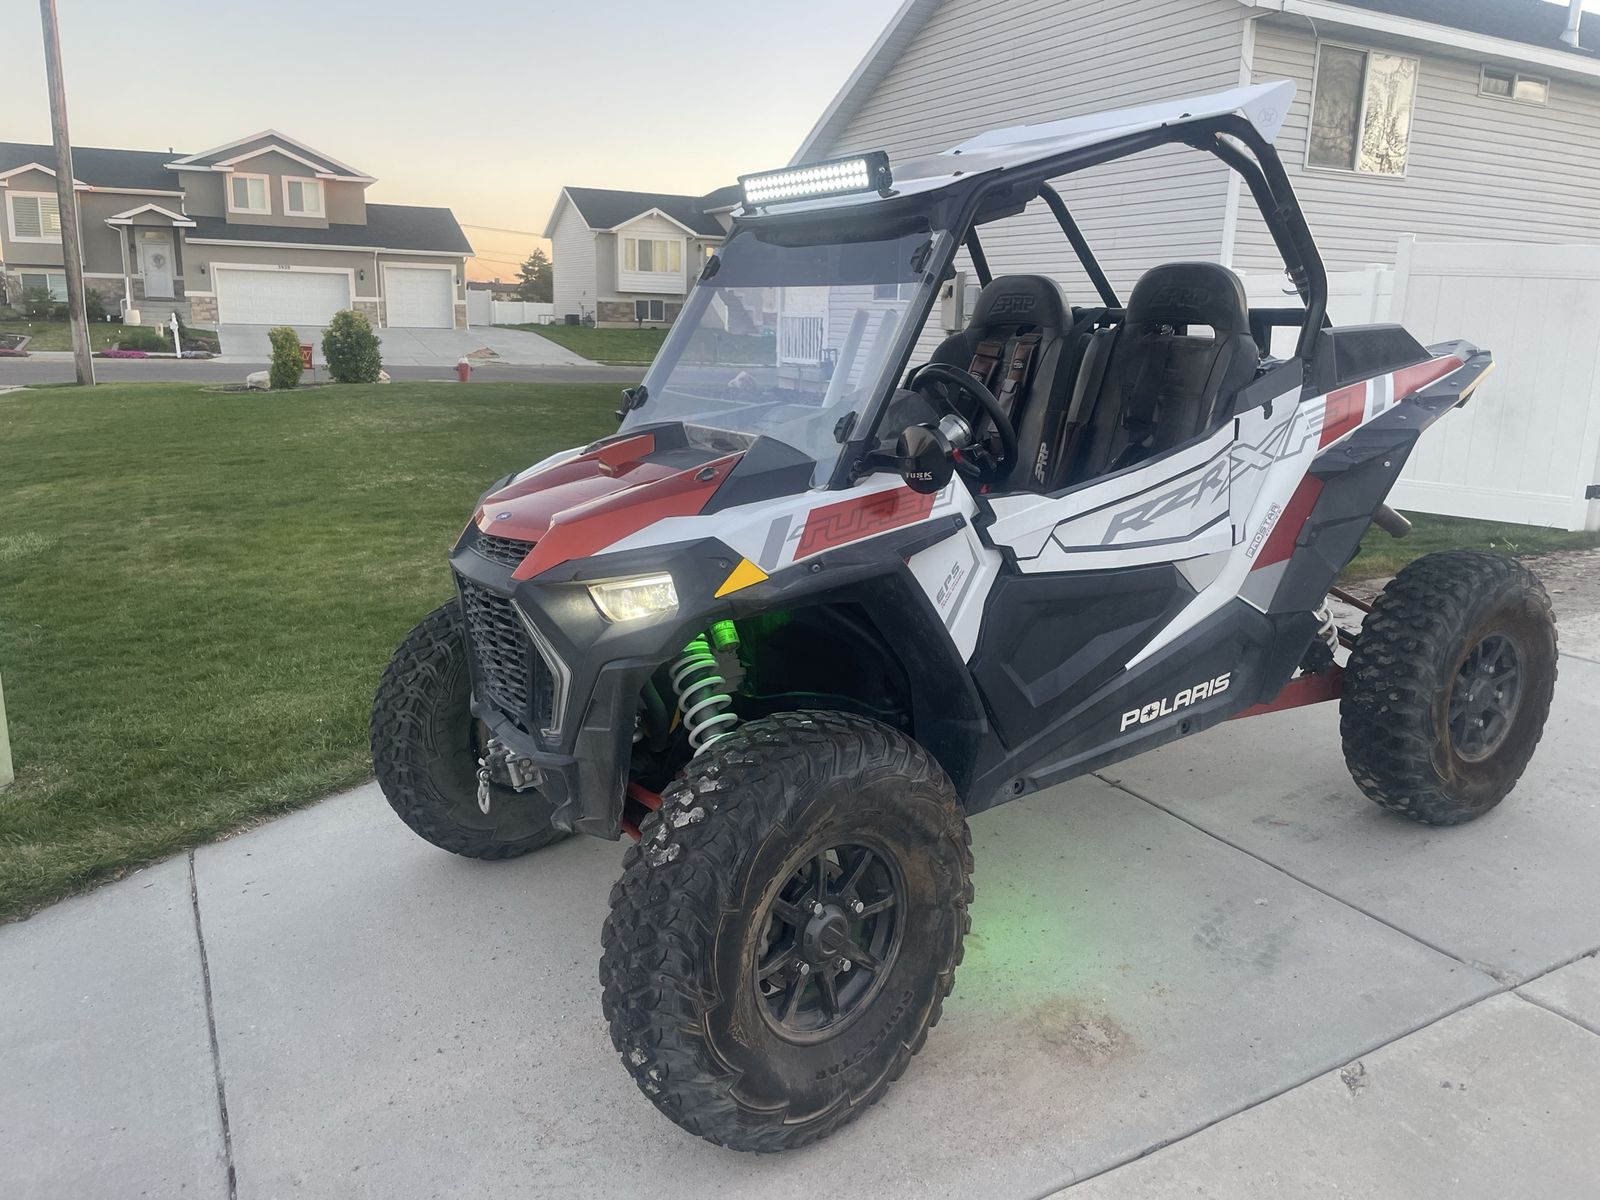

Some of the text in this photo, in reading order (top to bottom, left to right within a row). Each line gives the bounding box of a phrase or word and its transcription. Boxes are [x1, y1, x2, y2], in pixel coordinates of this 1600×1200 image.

[1245, 502, 1280, 559] PROSTAR
[936, 561, 960, 604] EPS
[1120, 672, 1231, 732] POLARIS
